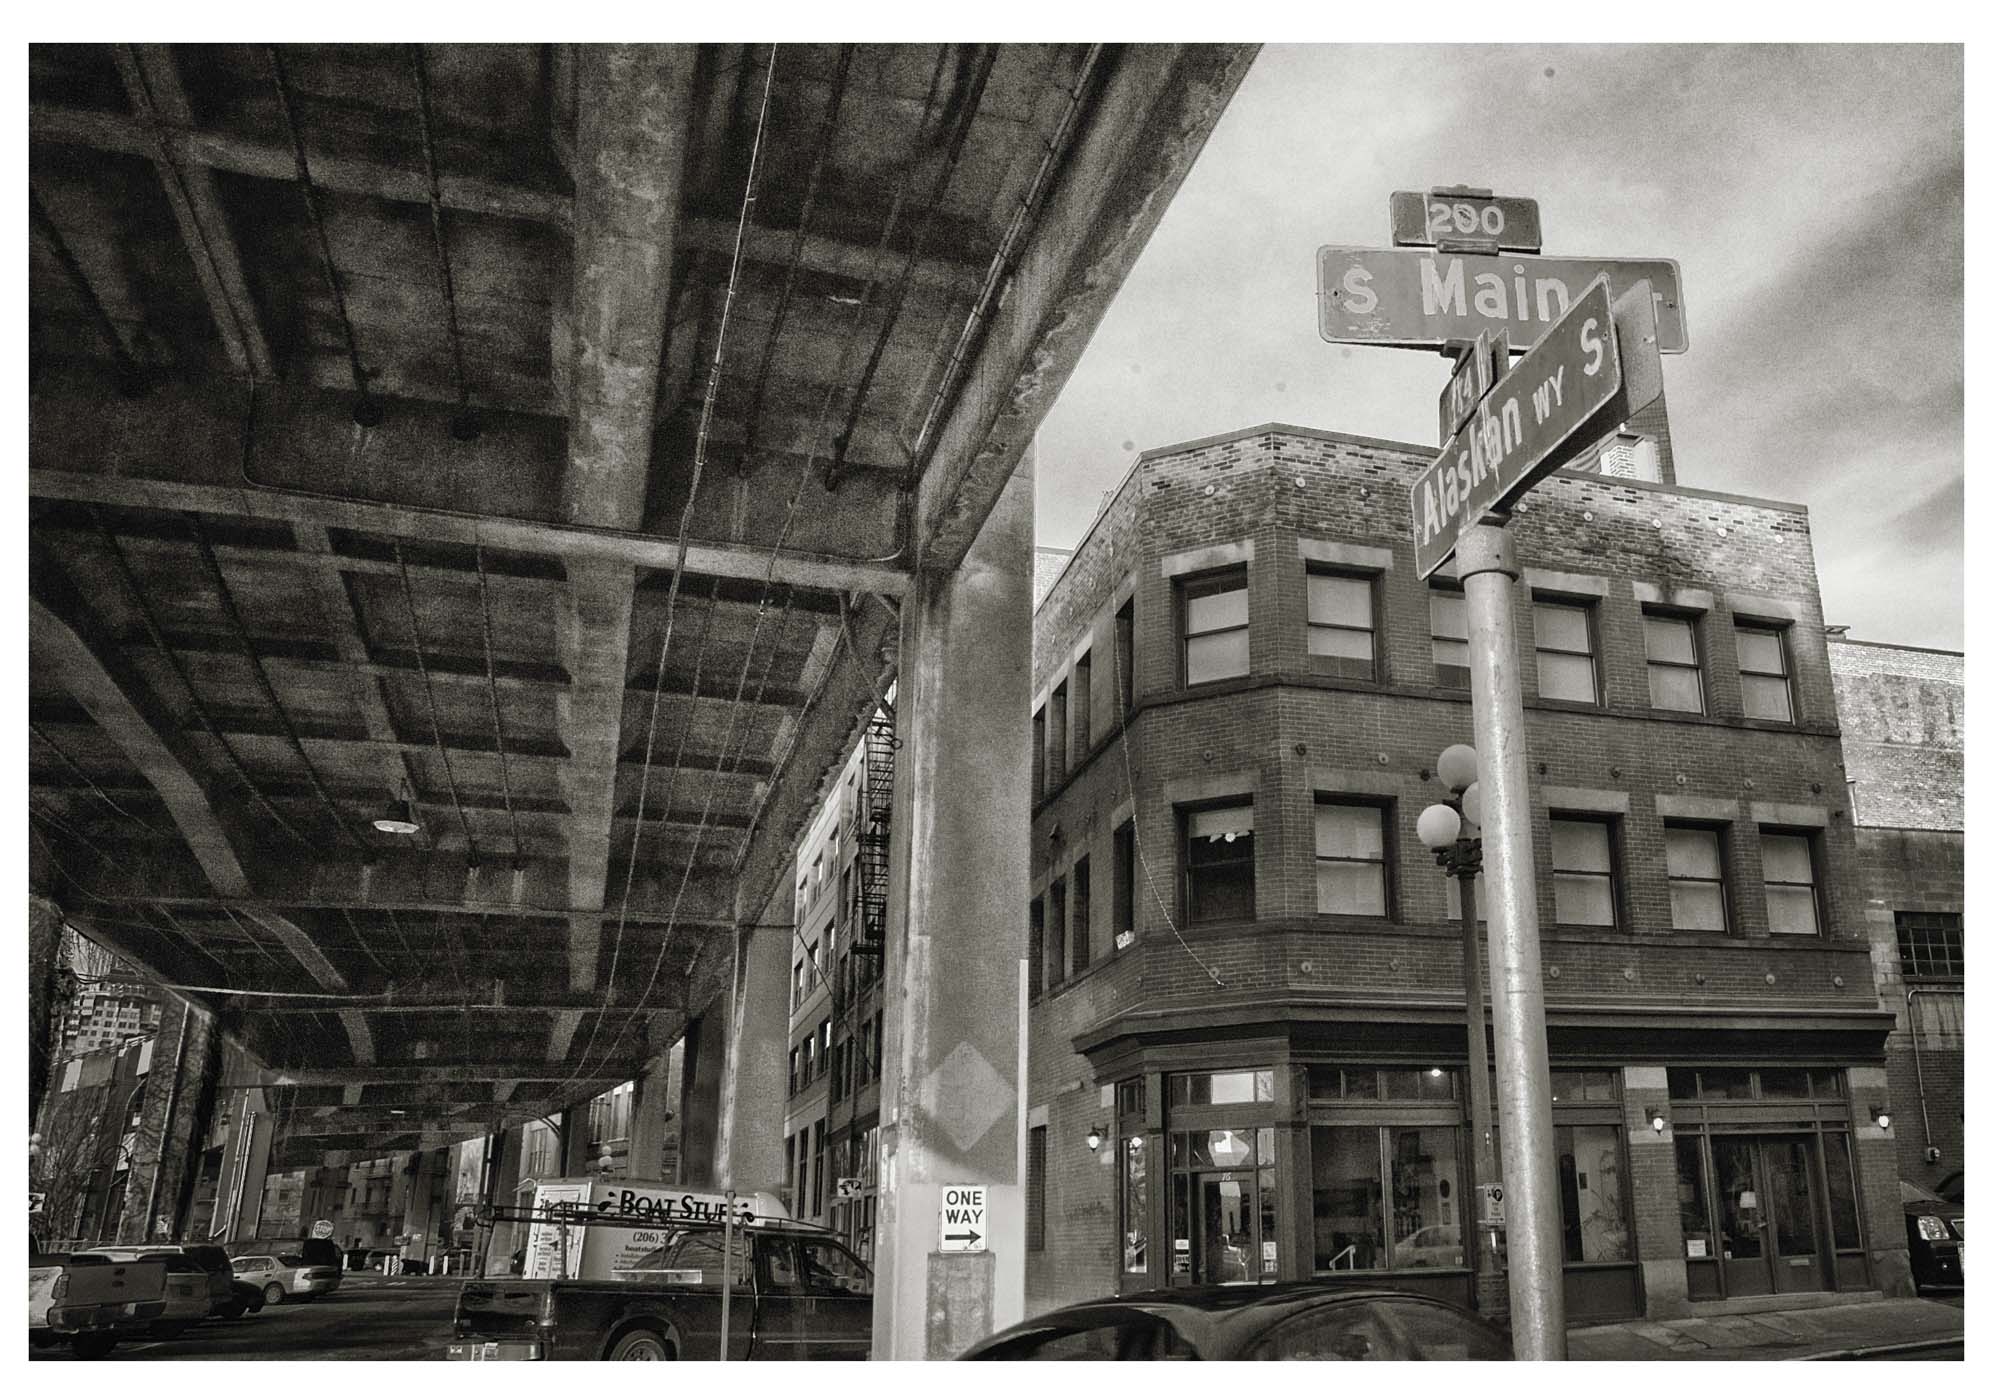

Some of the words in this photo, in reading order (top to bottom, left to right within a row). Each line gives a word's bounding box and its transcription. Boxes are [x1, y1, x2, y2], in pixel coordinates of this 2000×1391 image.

[1429, 203, 1505, 235] 200
[1342, 267, 1379, 314] S
[1420, 257, 1569, 322] Main
[1423, 397, 1523, 546] Alaskan
[1580, 317, 1604, 377] S
[680, 1194, 738, 1222] STUF
[946, 1190, 983, 1206] ONE
[945, 1208, 984, 1225] WAY
[632, 1231, 660, 1244] (206)
